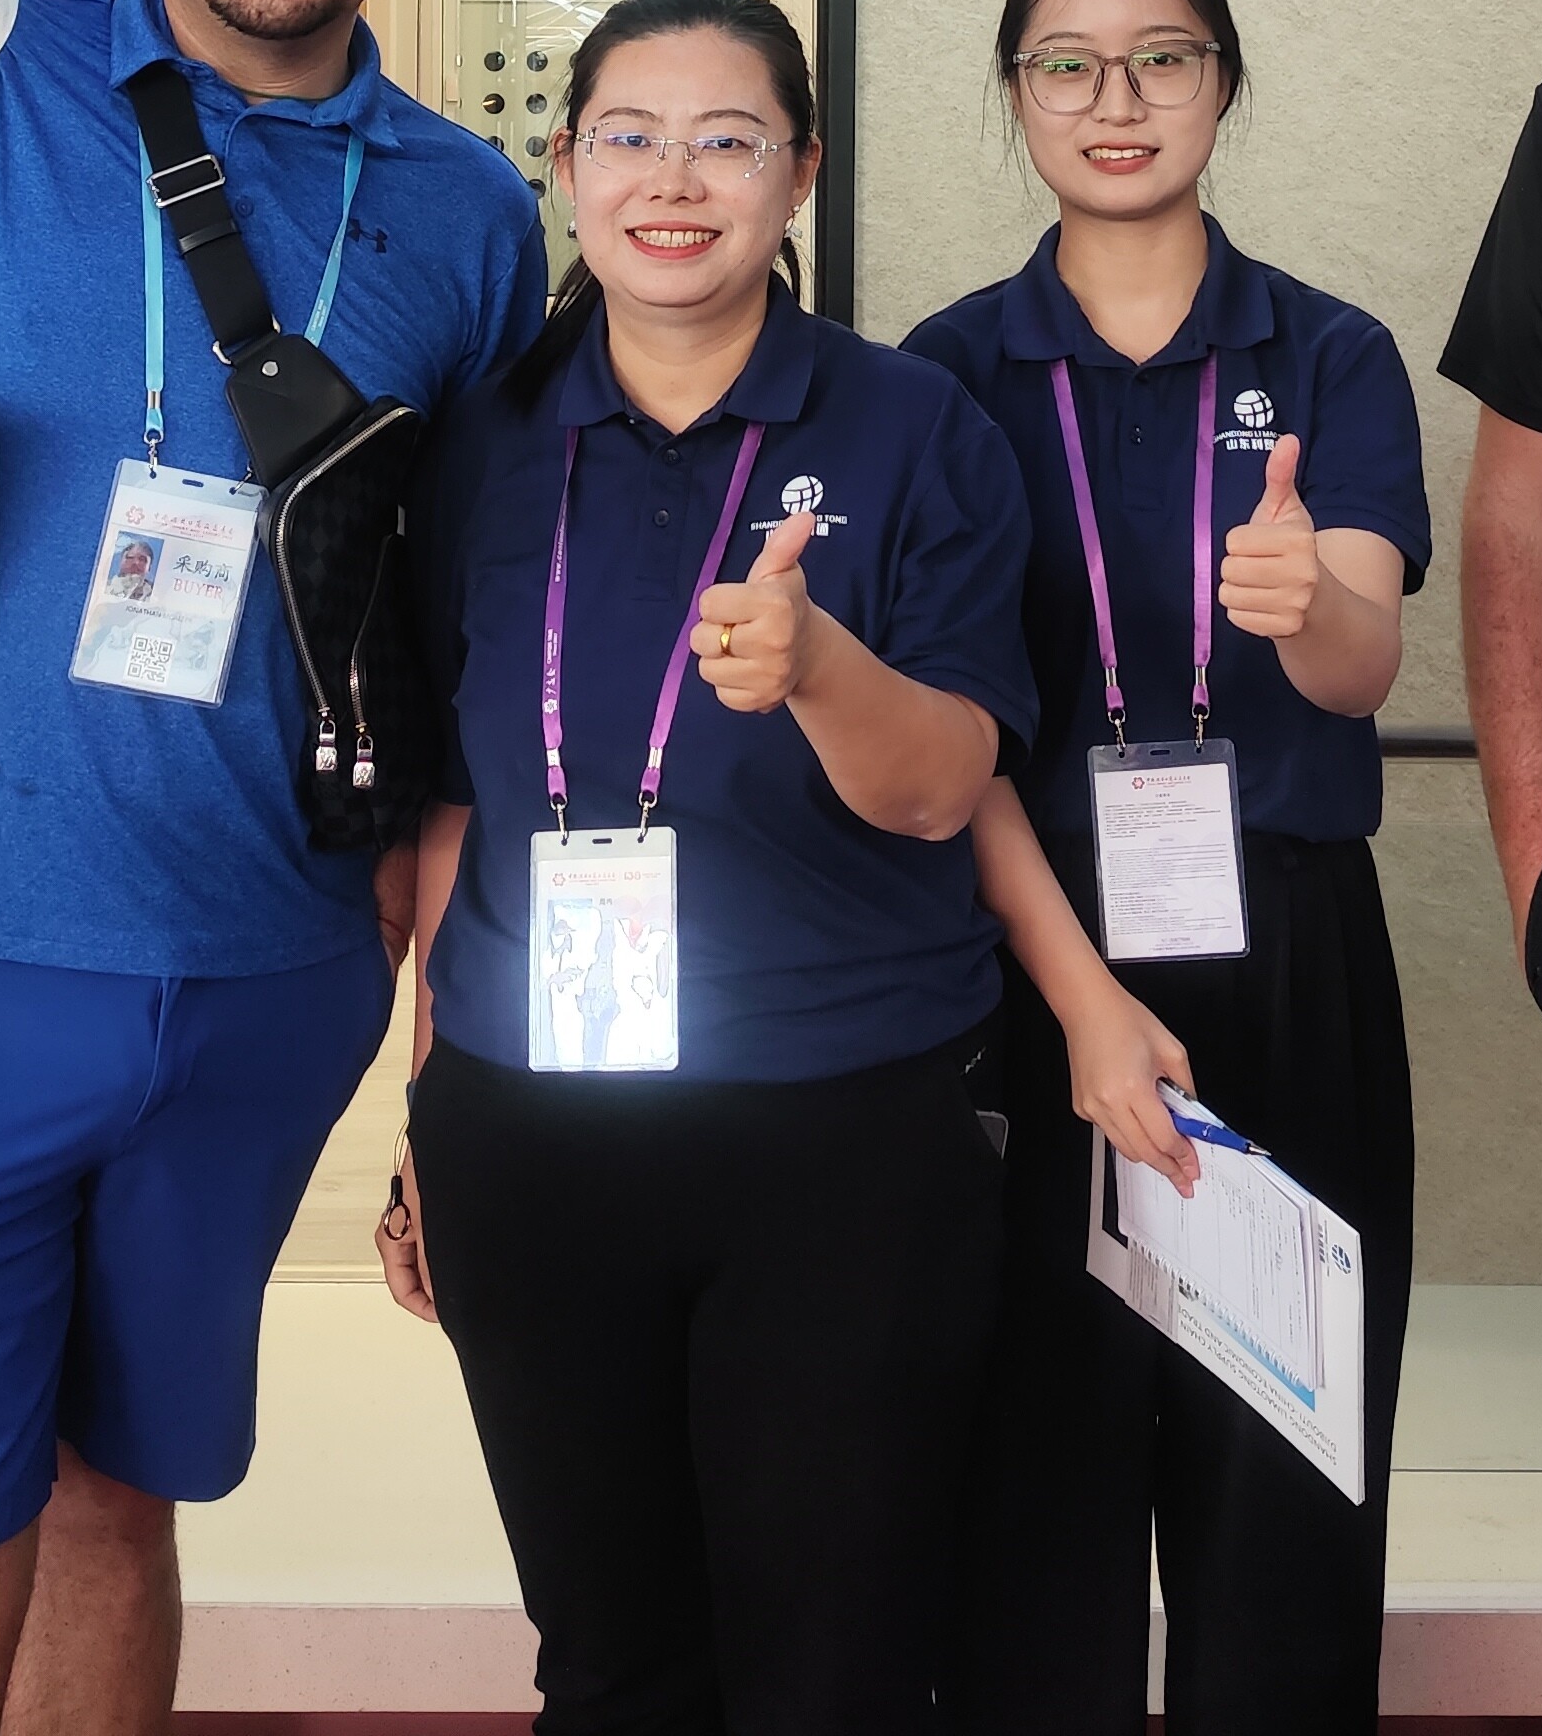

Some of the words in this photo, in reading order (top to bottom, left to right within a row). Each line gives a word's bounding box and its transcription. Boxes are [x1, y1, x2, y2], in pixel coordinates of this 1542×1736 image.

[172, 554, 233, 583] 采购商
[173, 577, 224, 600] BUYER
